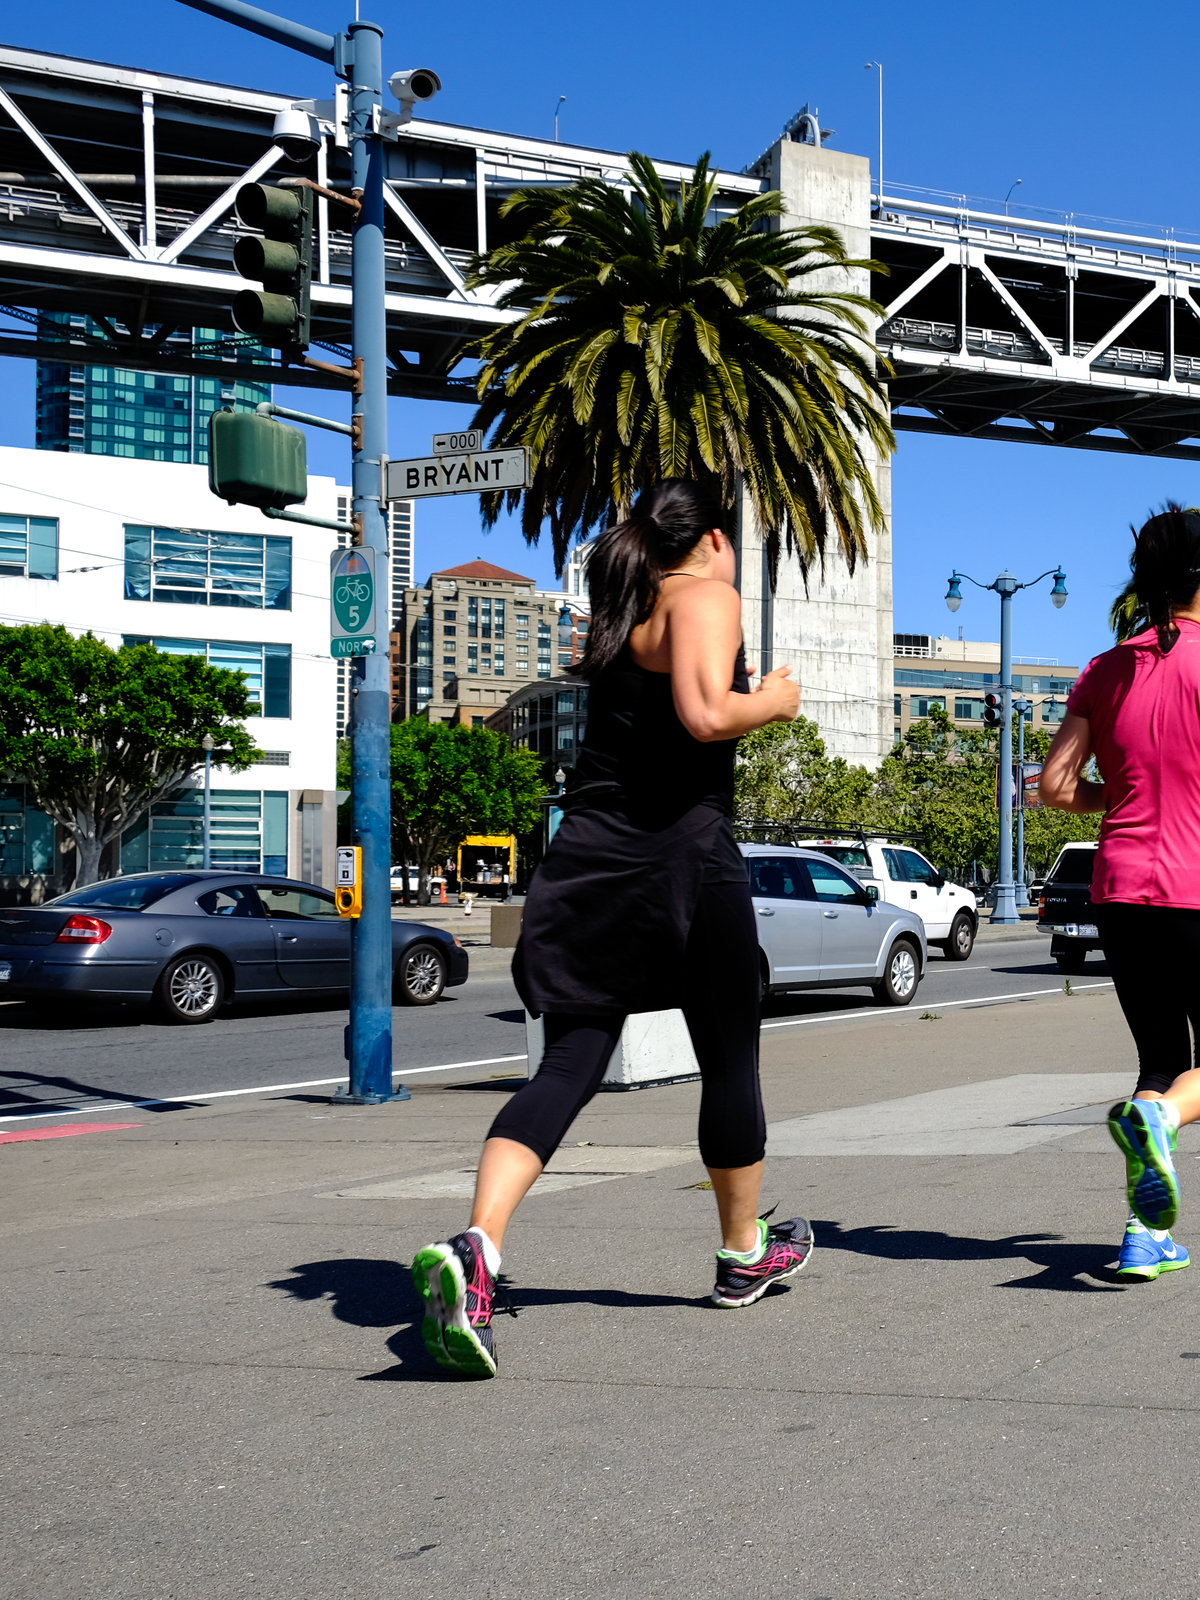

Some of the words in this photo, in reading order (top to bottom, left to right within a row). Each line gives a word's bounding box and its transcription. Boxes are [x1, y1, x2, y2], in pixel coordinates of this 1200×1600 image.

[450, 433, 476, 449] 000
[406, 458, 504, 489] BRYANT
[348, 606, 360, 627] 5
